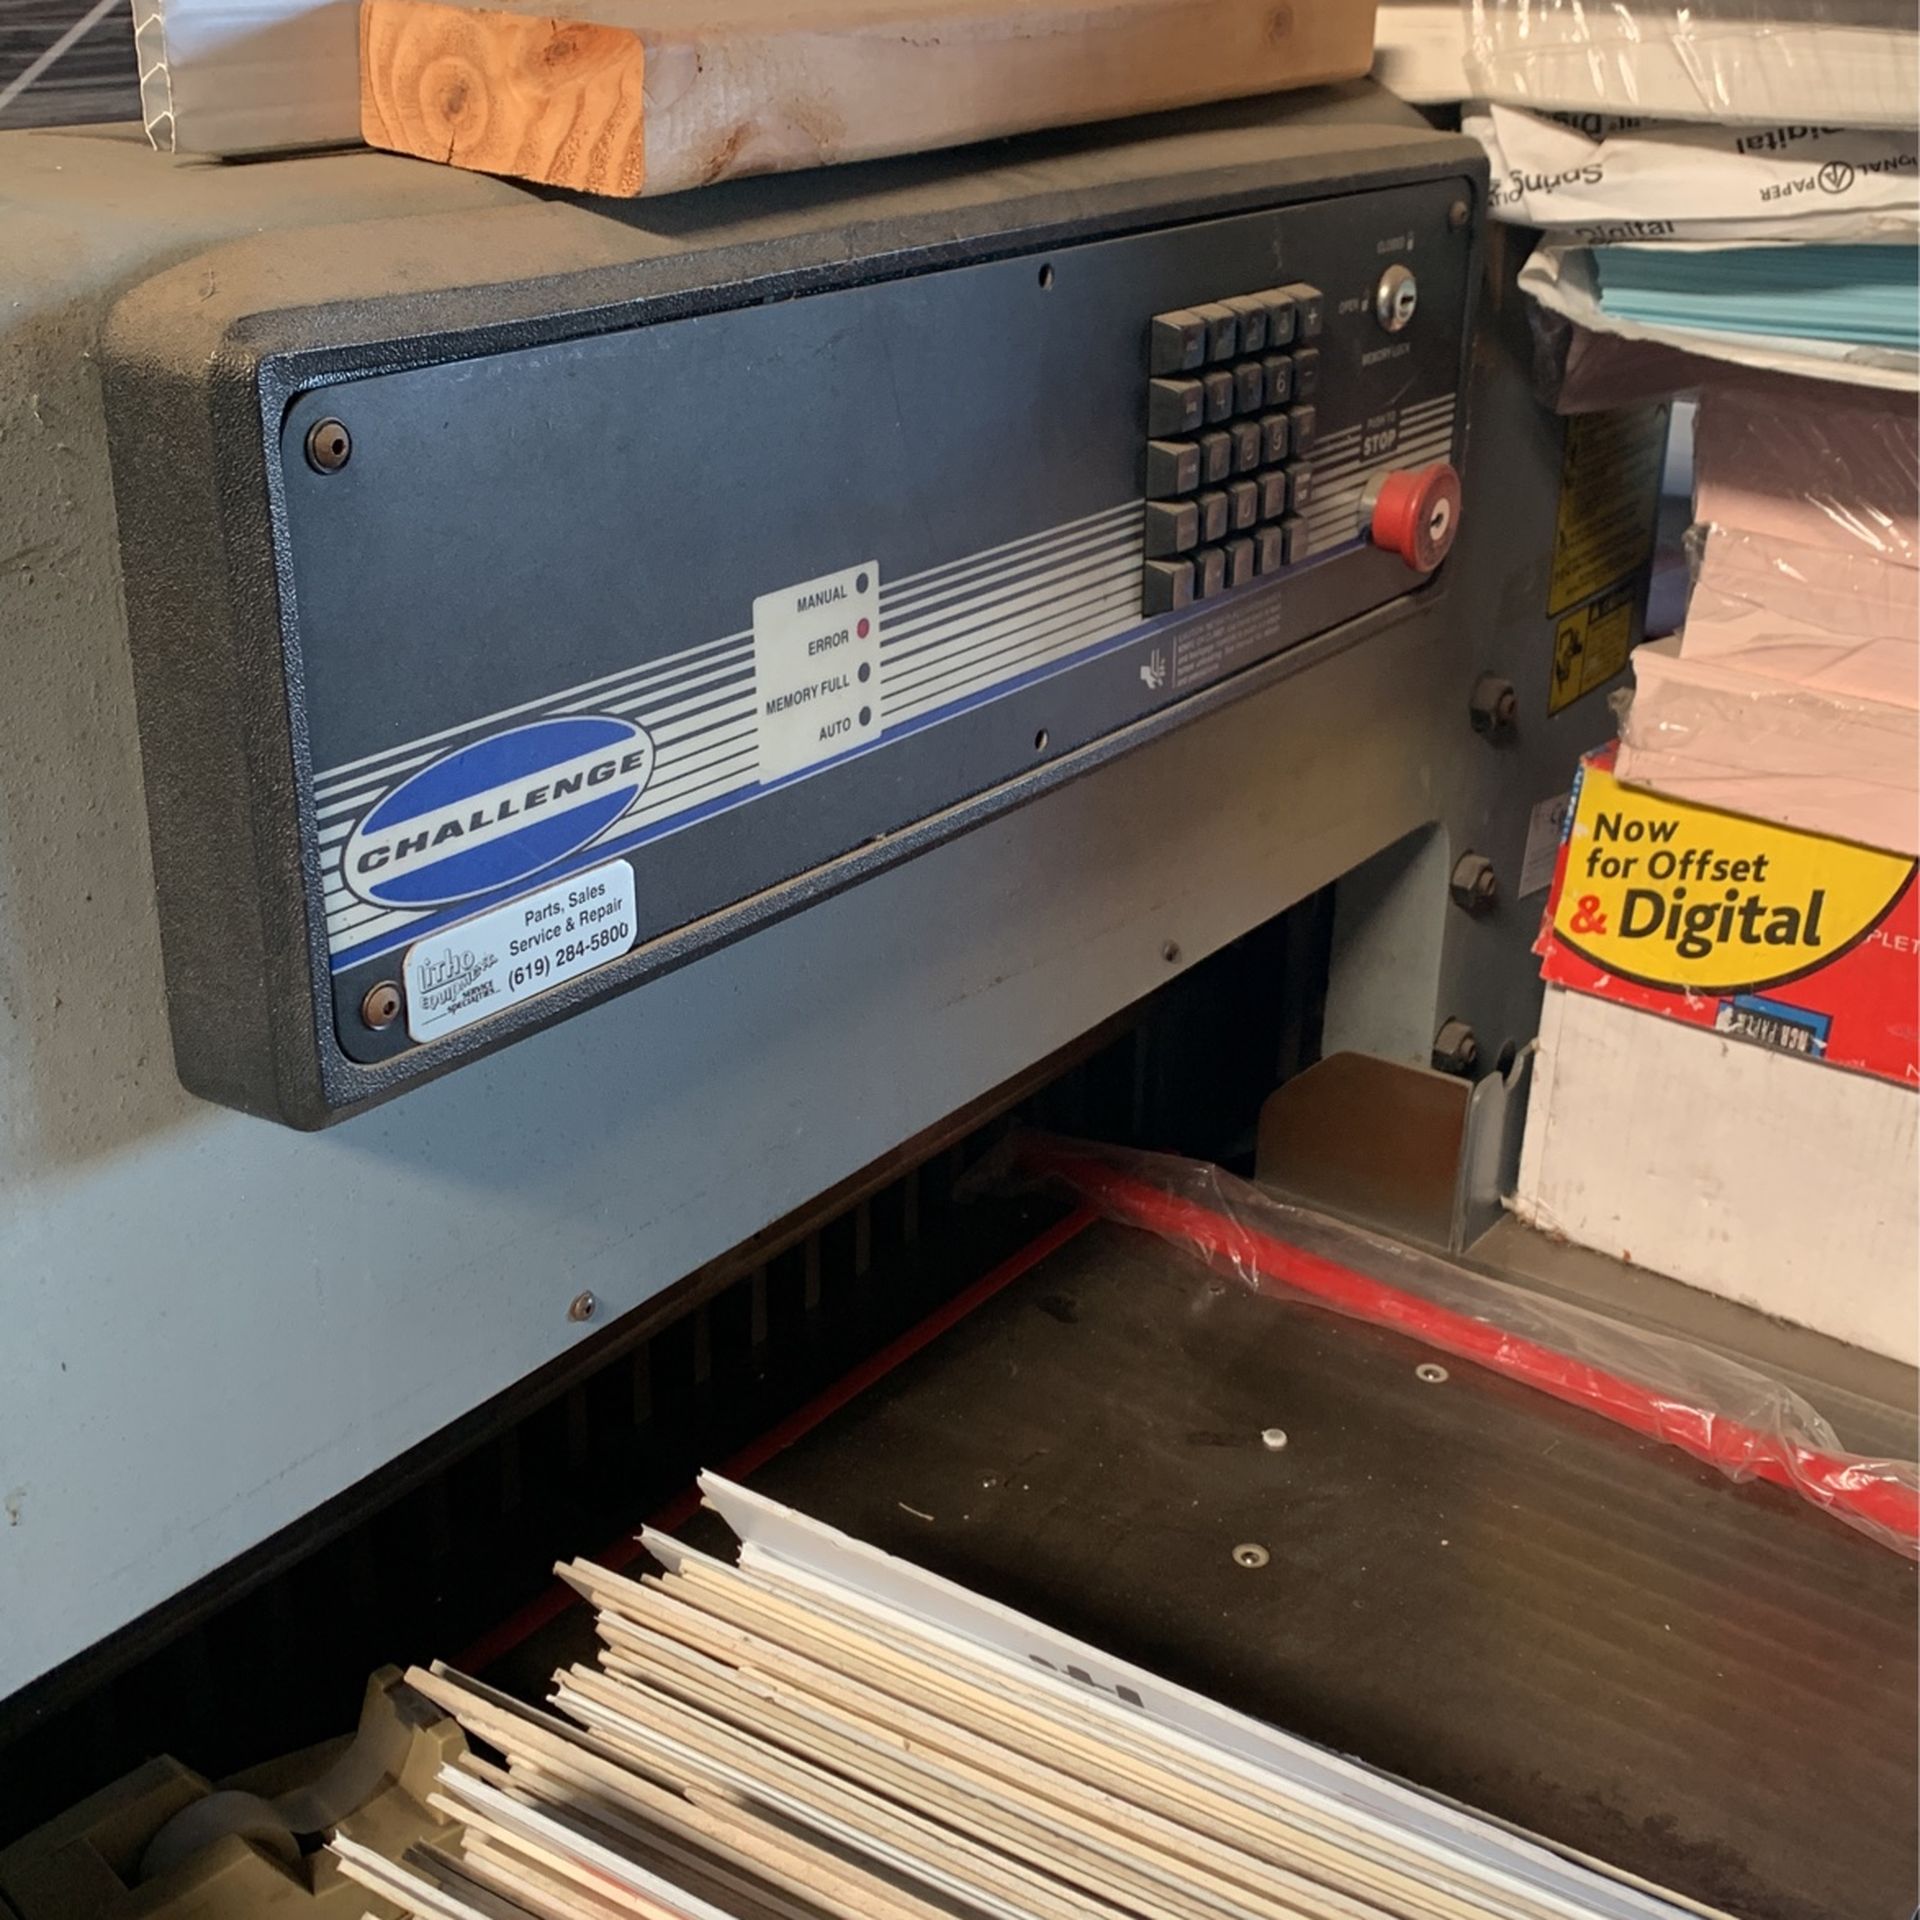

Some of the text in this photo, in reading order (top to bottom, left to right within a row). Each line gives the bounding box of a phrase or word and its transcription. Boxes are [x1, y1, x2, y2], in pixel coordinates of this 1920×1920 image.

[1760, 176, 1816, 201] PAPER
[1363, 429, 1396, 456] STOP
[797, 586, 847, 612] MANUAL
[808, 630, 849, 656] ERROR
[766, 674, 849, 715] MEMORY FULL
[819, 717, 851, 741] AUTO
[357, 750, 645, 874] CHALLENGE
[1593, 813, 1679, 842] Now
[1586, 848, 1769, 882] for Offset
[525, 884, 606, 926] Parts, Sales
[510, 898, 622, 956] Service & Repair
[1569, 886, 1825, 959] & Digital
[508, 956, 550, 992] (619)
[556, 922, 628, 967] 284-5800
